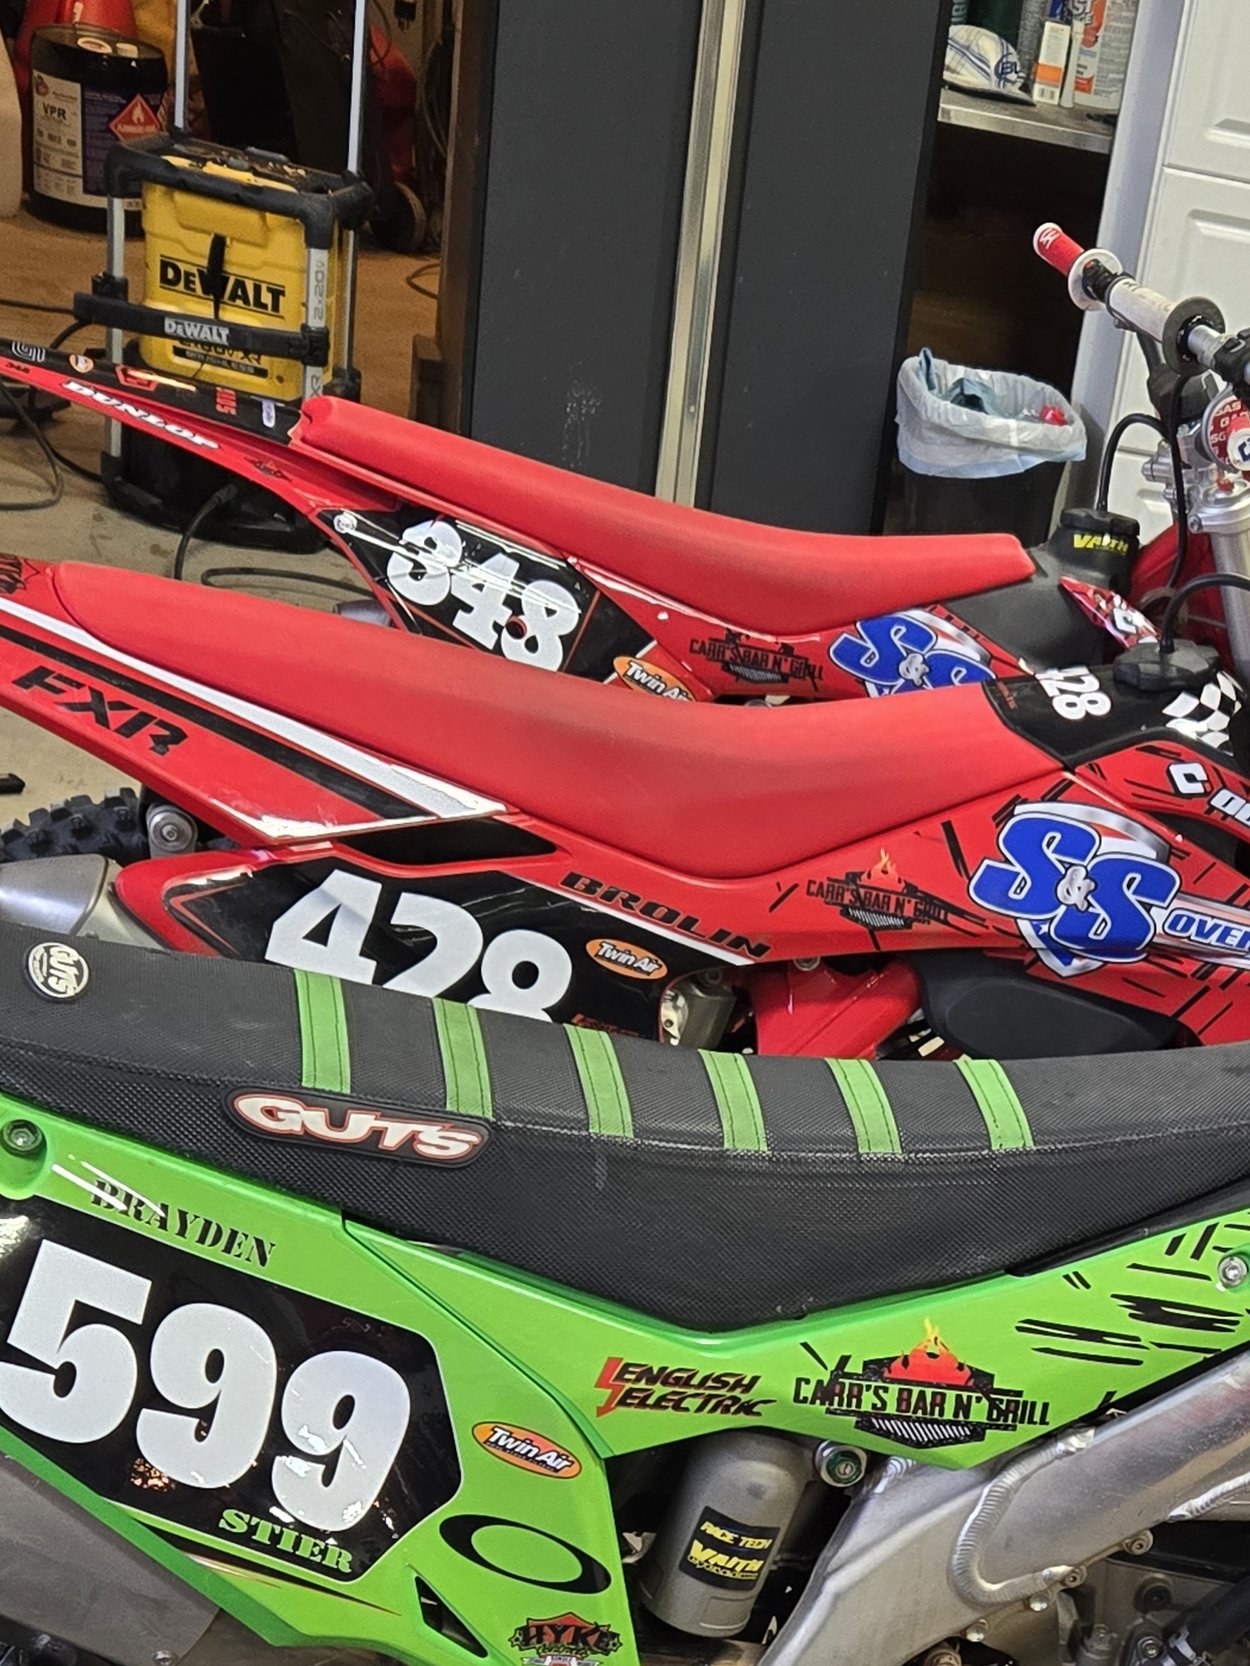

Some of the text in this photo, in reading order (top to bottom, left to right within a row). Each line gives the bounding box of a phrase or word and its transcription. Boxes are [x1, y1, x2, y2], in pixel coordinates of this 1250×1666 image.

[62, 380, 220, 450] DUNLOP
[386, 518, 580, 672] 348
[11, 665, 189, 756] FXR
[624, 661, 667, 695] Twin
[560, 871, 772, 959] BROLIN
[863, 889, 892, 913] BAR
[967, 812, 1180, 964] S&S
[265, 868, 572, 1021] 428
[598, 942, 662, 976] Twin Air
[232, 1091, 485, 1162] GUTS
[92, 1179, 277, 1268] BRAYDEN
[0, 1239, 411, 1531] 599
[612, 1362, 762, 1395] ENGLISH
[793, 1376, 889, 1413] CARR'S
[896, 1387, 947, 1419] BAR
[986, 1396, 1051, 1427] GRILL
[486, 1425, 541, 1459] Twin
[534, 1449, 575, 1472] Air
[218, 1506, 354, 1576] STIER
